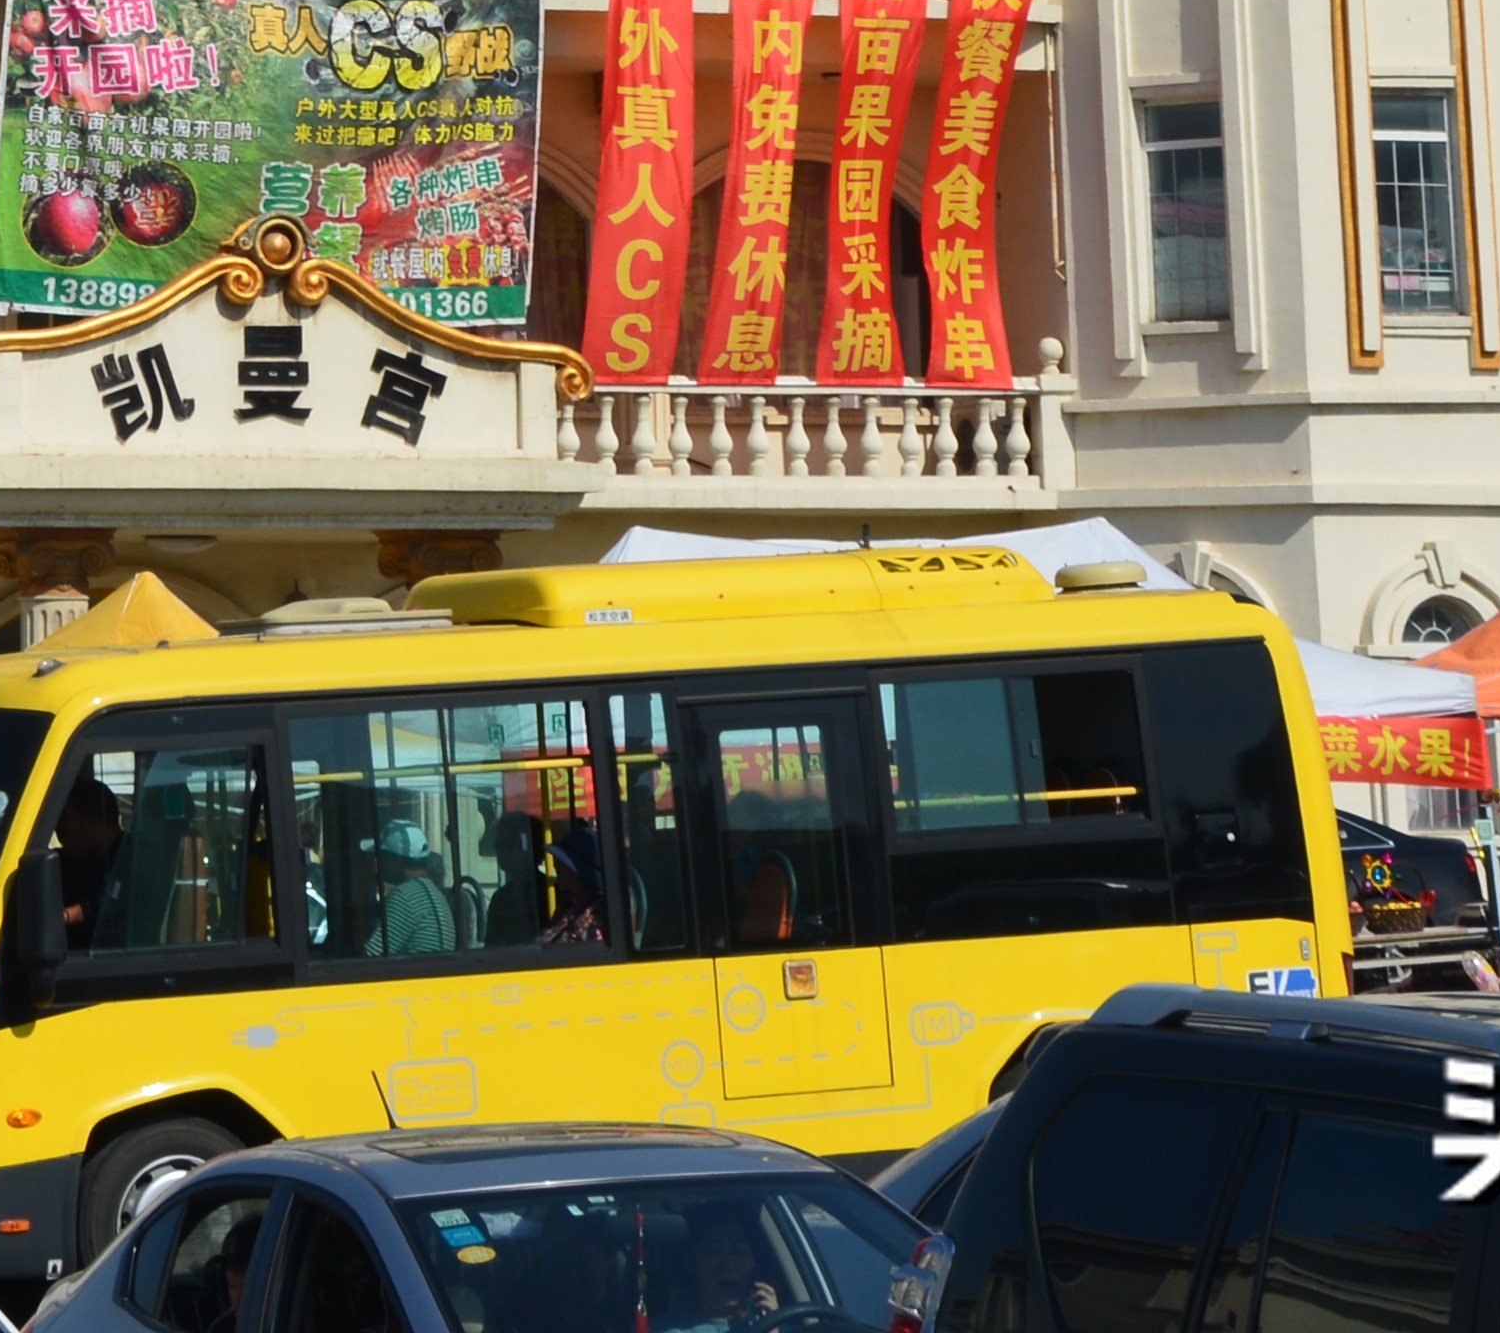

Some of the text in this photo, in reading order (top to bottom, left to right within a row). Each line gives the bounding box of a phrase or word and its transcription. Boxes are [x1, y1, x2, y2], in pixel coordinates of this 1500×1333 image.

[389, 157, 502, 209] 各种炸串
[415, 201, 480, 240] 烤肠
[386, 290, 489, 317] 01366
[90, 325, 447, 447] 凯曼宫
